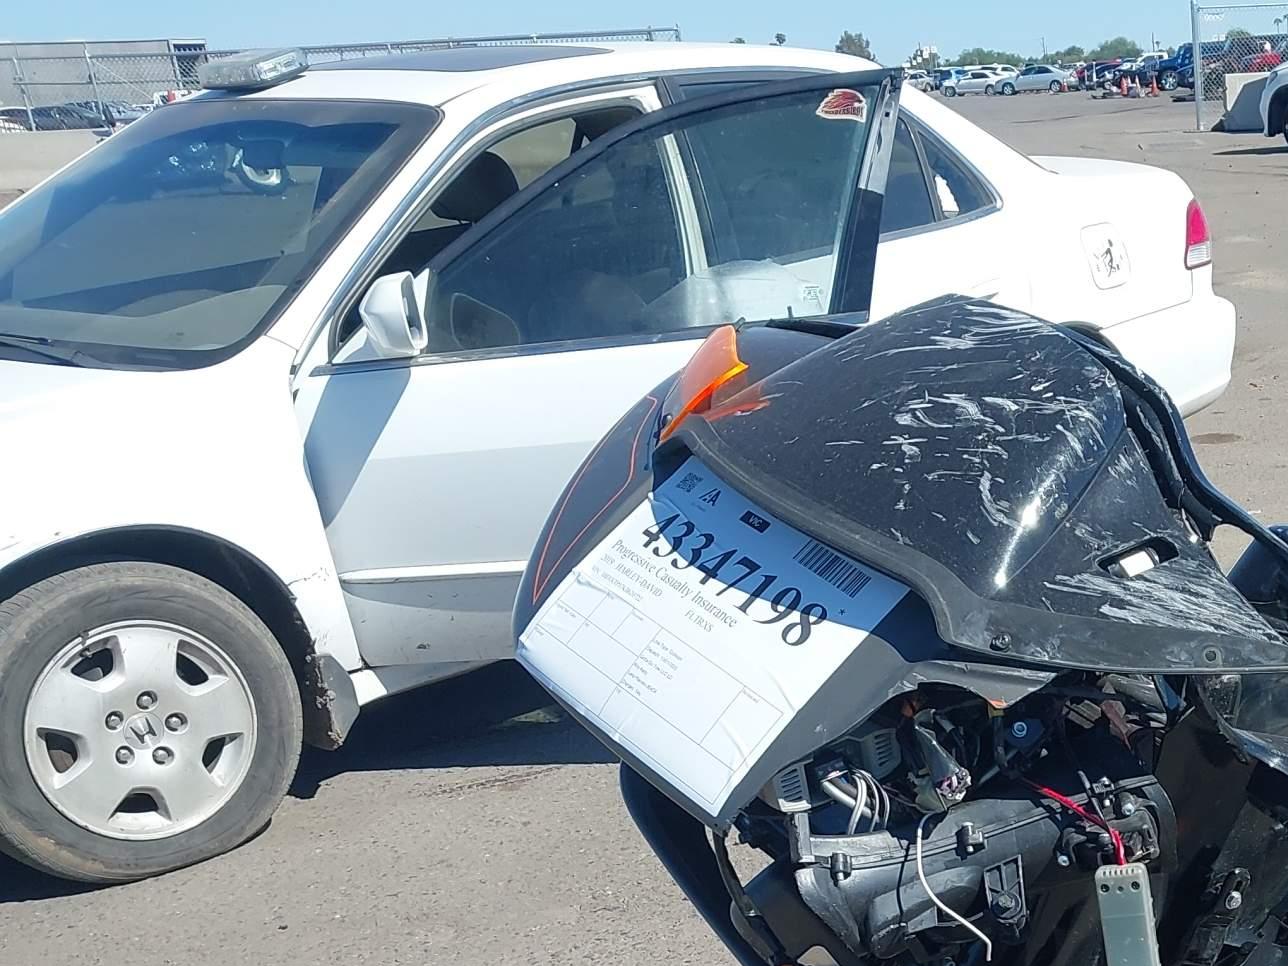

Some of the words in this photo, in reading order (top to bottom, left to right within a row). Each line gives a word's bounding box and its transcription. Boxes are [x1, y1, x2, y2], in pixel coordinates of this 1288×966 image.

[612, 539, 657, 574] Progressive
[655, 566, 694, 599] Casualty
[692, 590, 738, 628] Insurance
[642, 513, 828, 646] 43347198
